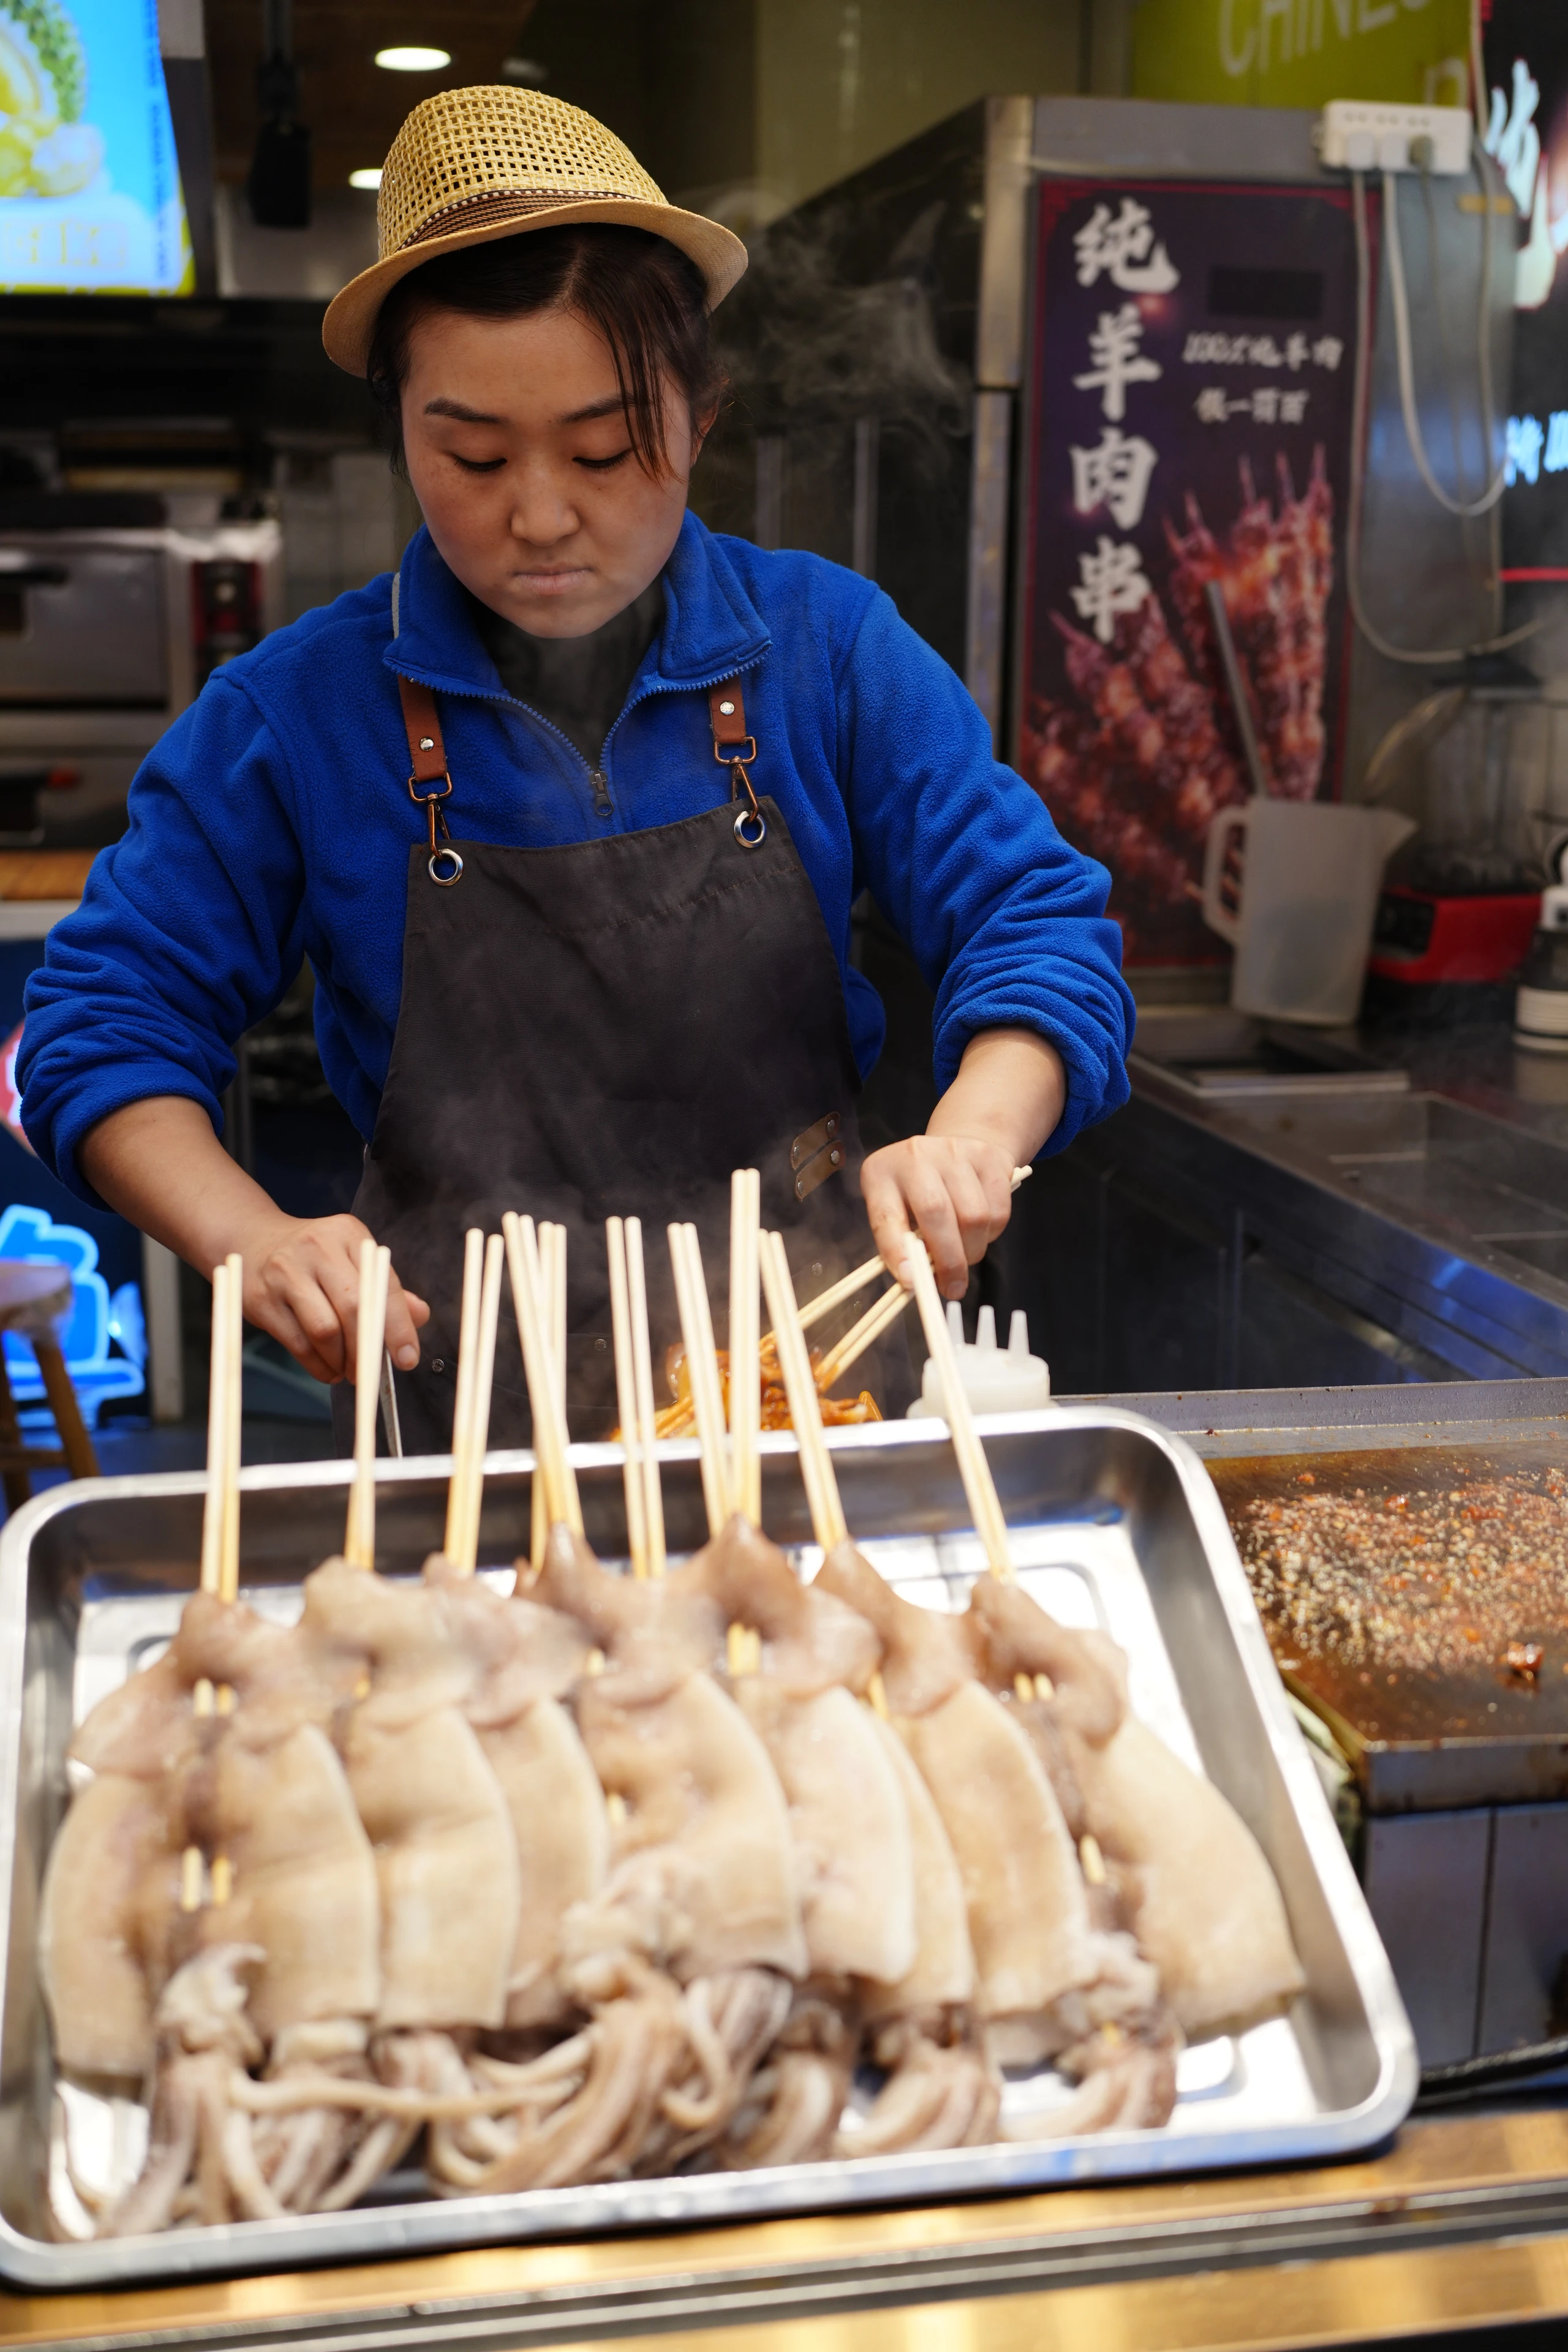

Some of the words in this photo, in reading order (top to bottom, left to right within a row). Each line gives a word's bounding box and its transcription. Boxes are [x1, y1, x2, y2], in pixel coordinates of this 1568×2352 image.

[1219, 0, 1431, 77] CHIN
[1070, 197, 1180, 643] 纯羊肉串
